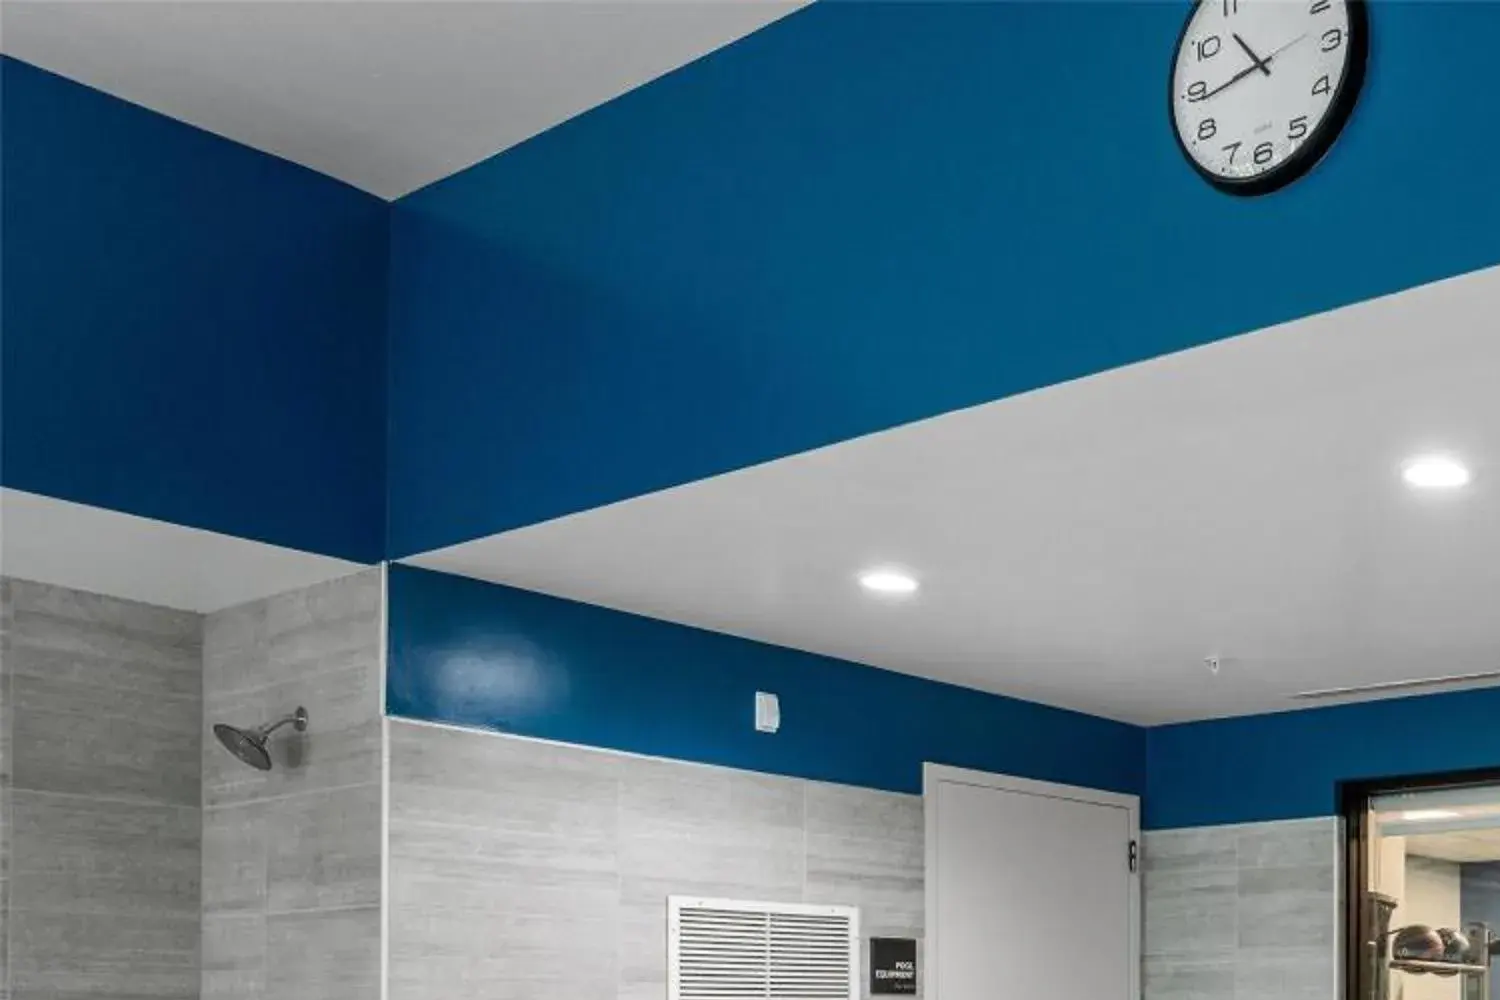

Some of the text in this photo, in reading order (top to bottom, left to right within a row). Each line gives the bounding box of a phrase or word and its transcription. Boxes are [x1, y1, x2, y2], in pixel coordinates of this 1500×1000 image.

[1197, 35, 1220, 61] 10
[1321, 29, 1341, 52] 3
[1187, 81, 1207, 102] 9
[1312, 73, 1331, 95] 4
[1198, 118, 1217, 140] 8
[1288, 116, 1307, 139] 5
[1222, 141, 1242, 164] 7
[1253, 142, 1273, 164] 6
